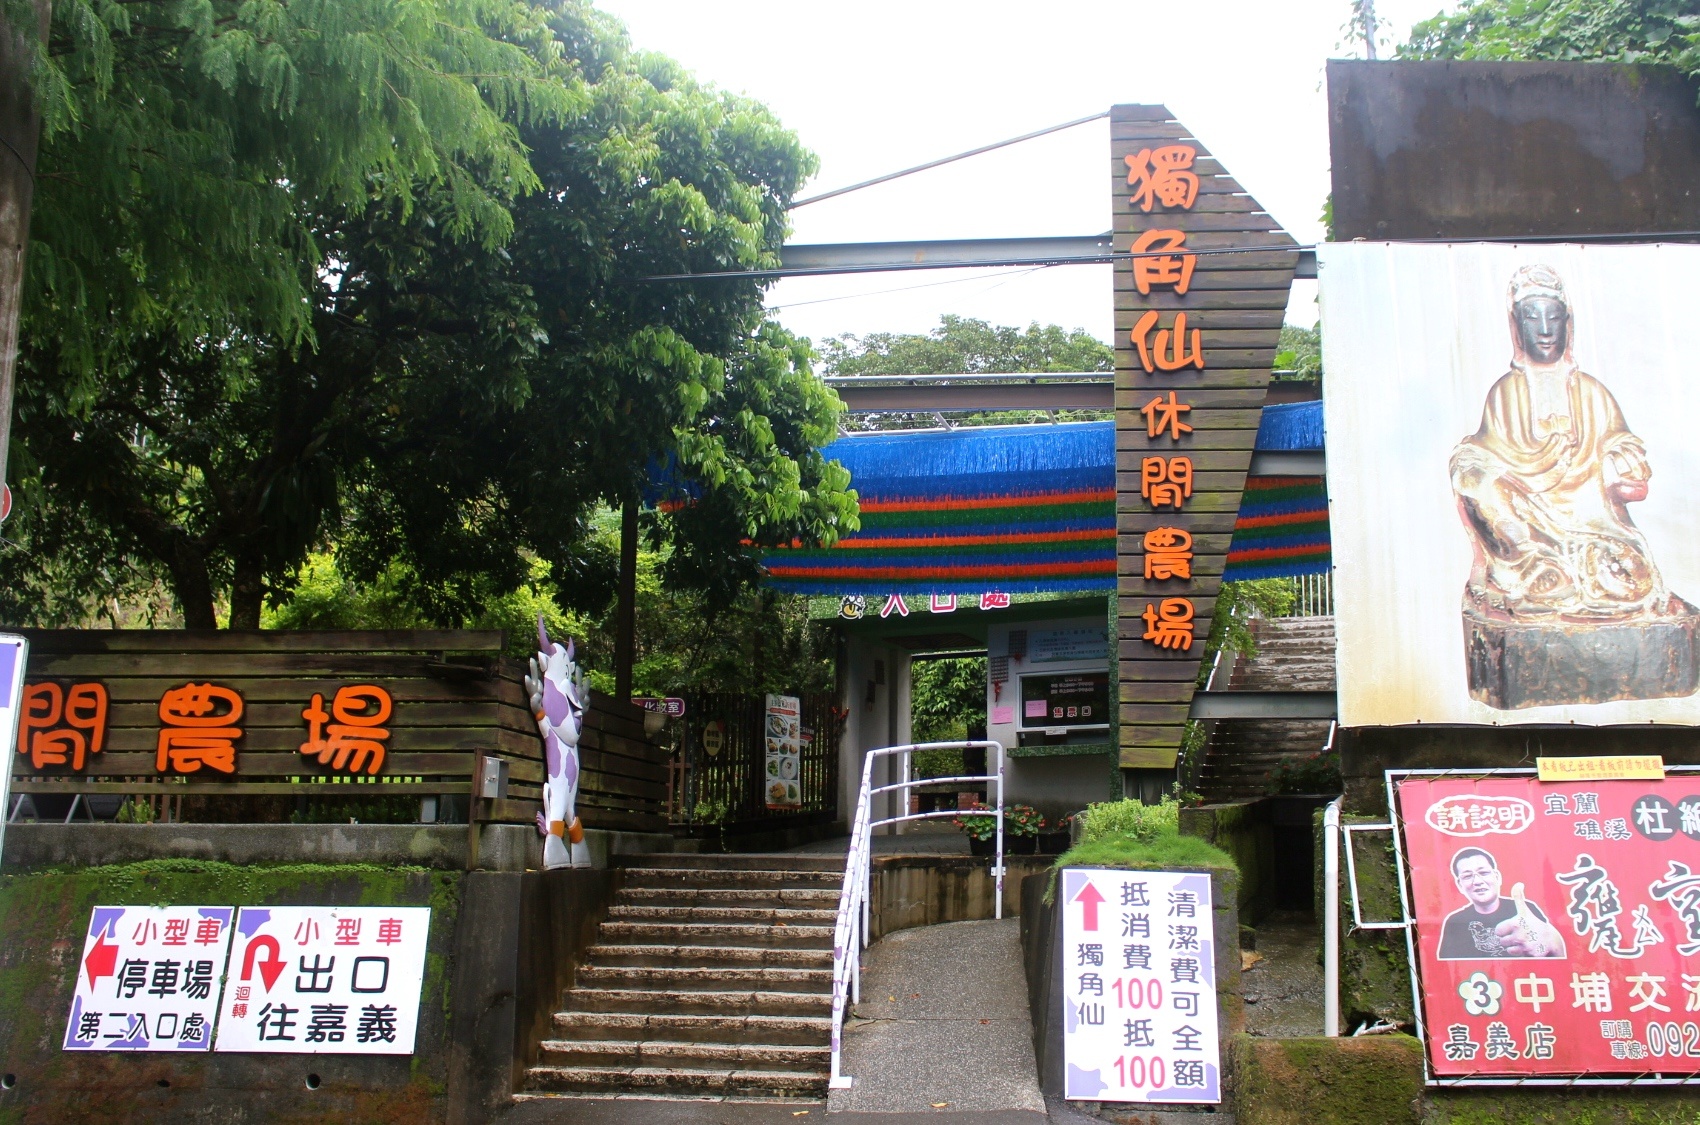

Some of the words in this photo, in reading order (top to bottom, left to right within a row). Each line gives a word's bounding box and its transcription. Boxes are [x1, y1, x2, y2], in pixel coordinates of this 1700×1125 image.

[1437, 804, 1527, 830] 請認明
[1544, 793, 1599, 815] 宜蘭
[1575, 818, 1632, 840] 礁溪
[132, 918, 222, 946] 小型車
[294, 917, 404, 946] 小型車
[116, 958, 213, 999] 停車場
[295, 954, 390, 994] 出口
[1077, 943, 1105, 1026] 獨角仙
[1167, 892, 1205, 1087] 清潔費可全額
[231, 985, 251, 1019] 迴轉
[1473, 981, 1489, 1007] 3
[77, 1011, 205, 1042] 第二入口處
[257, 1002, 398, 1043] 往嘉義
[1600, 1020, 1632, 1038] 訂購
[1444, 1023, 1556, 1060] 嘉義店
